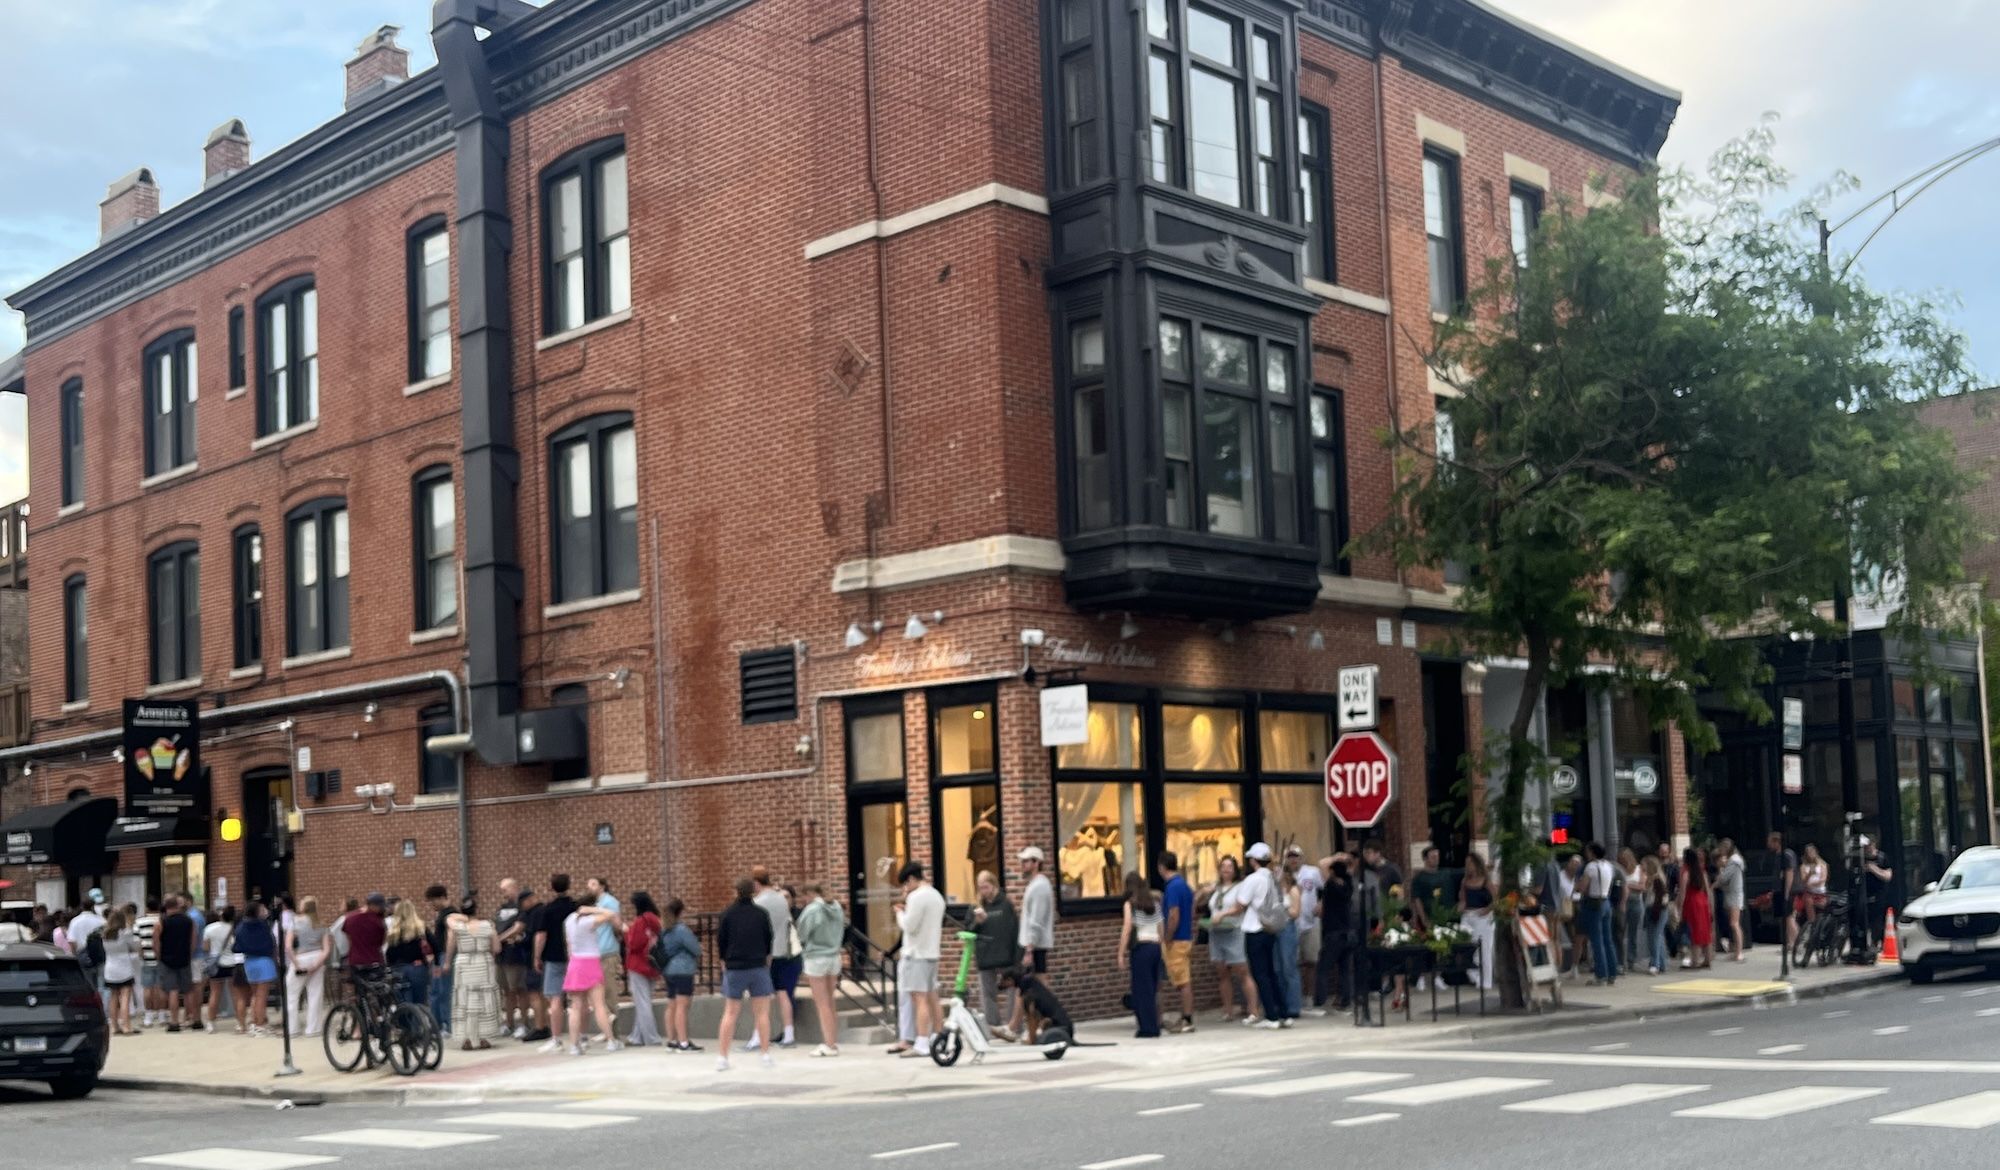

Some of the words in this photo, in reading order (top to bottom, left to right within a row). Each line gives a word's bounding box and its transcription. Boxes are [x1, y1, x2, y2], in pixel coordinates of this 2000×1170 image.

[1343, 673, 1368, 687] ONE
[1343, 690, 1368, 703] WAY
[1330, 760, 1387, 798] STOP
